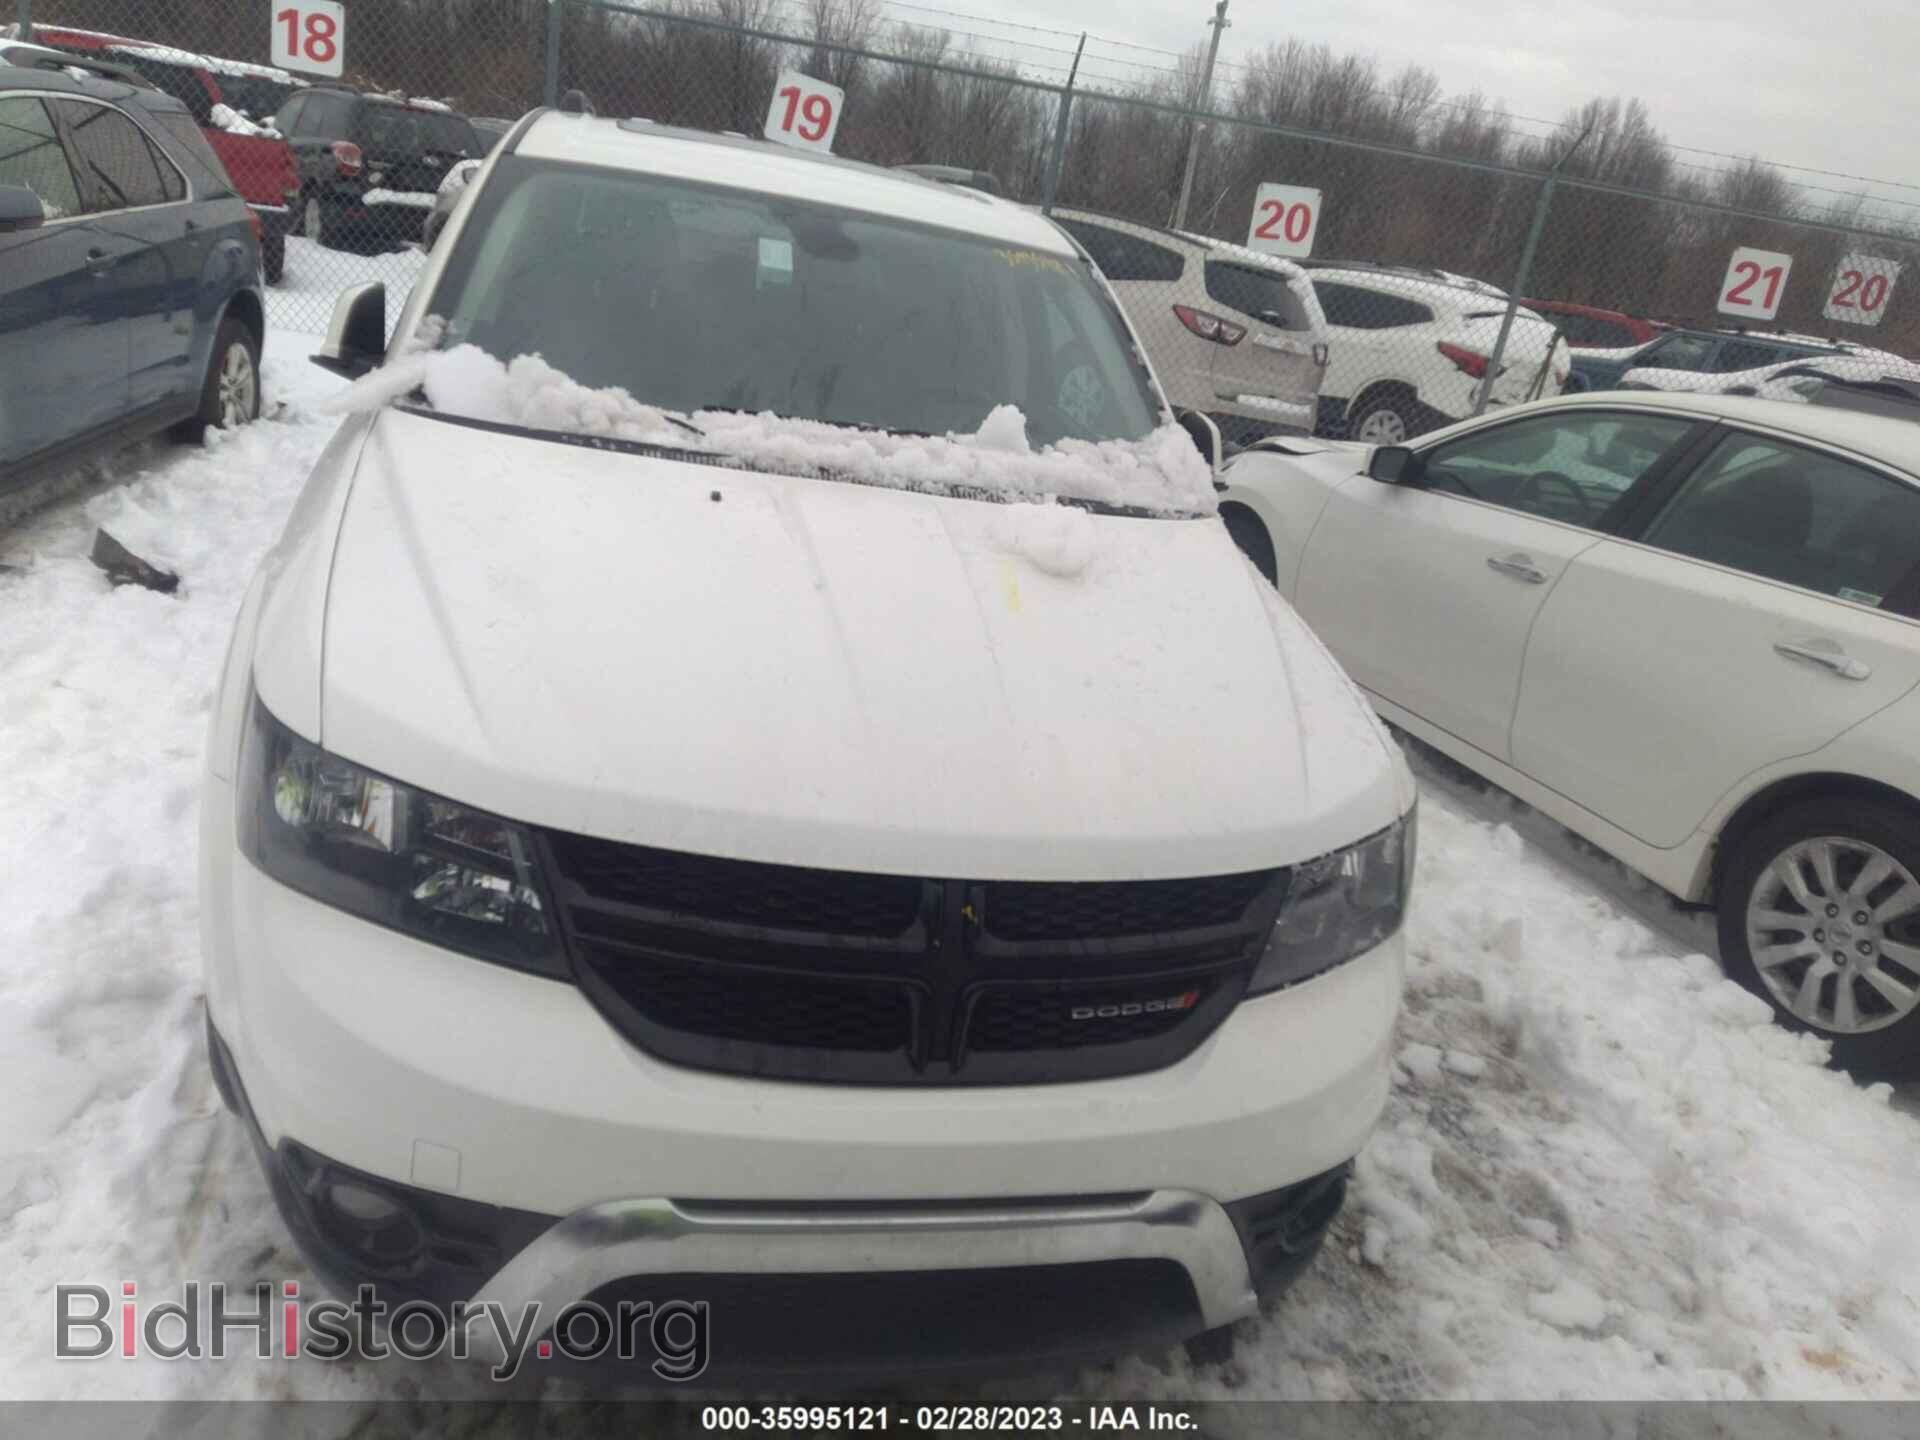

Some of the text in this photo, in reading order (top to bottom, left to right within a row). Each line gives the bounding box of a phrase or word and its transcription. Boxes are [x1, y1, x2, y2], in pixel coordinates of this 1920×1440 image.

[277, 8, 337, 63] 18
[779, 85, 833, 142] 19
[1254, 200, 1312, 243] 20
[1725, 261, 1785, 309] 21
[1831, 270, 1889, 312] 20
[1071, 996, 1184, 1020] DODGE
